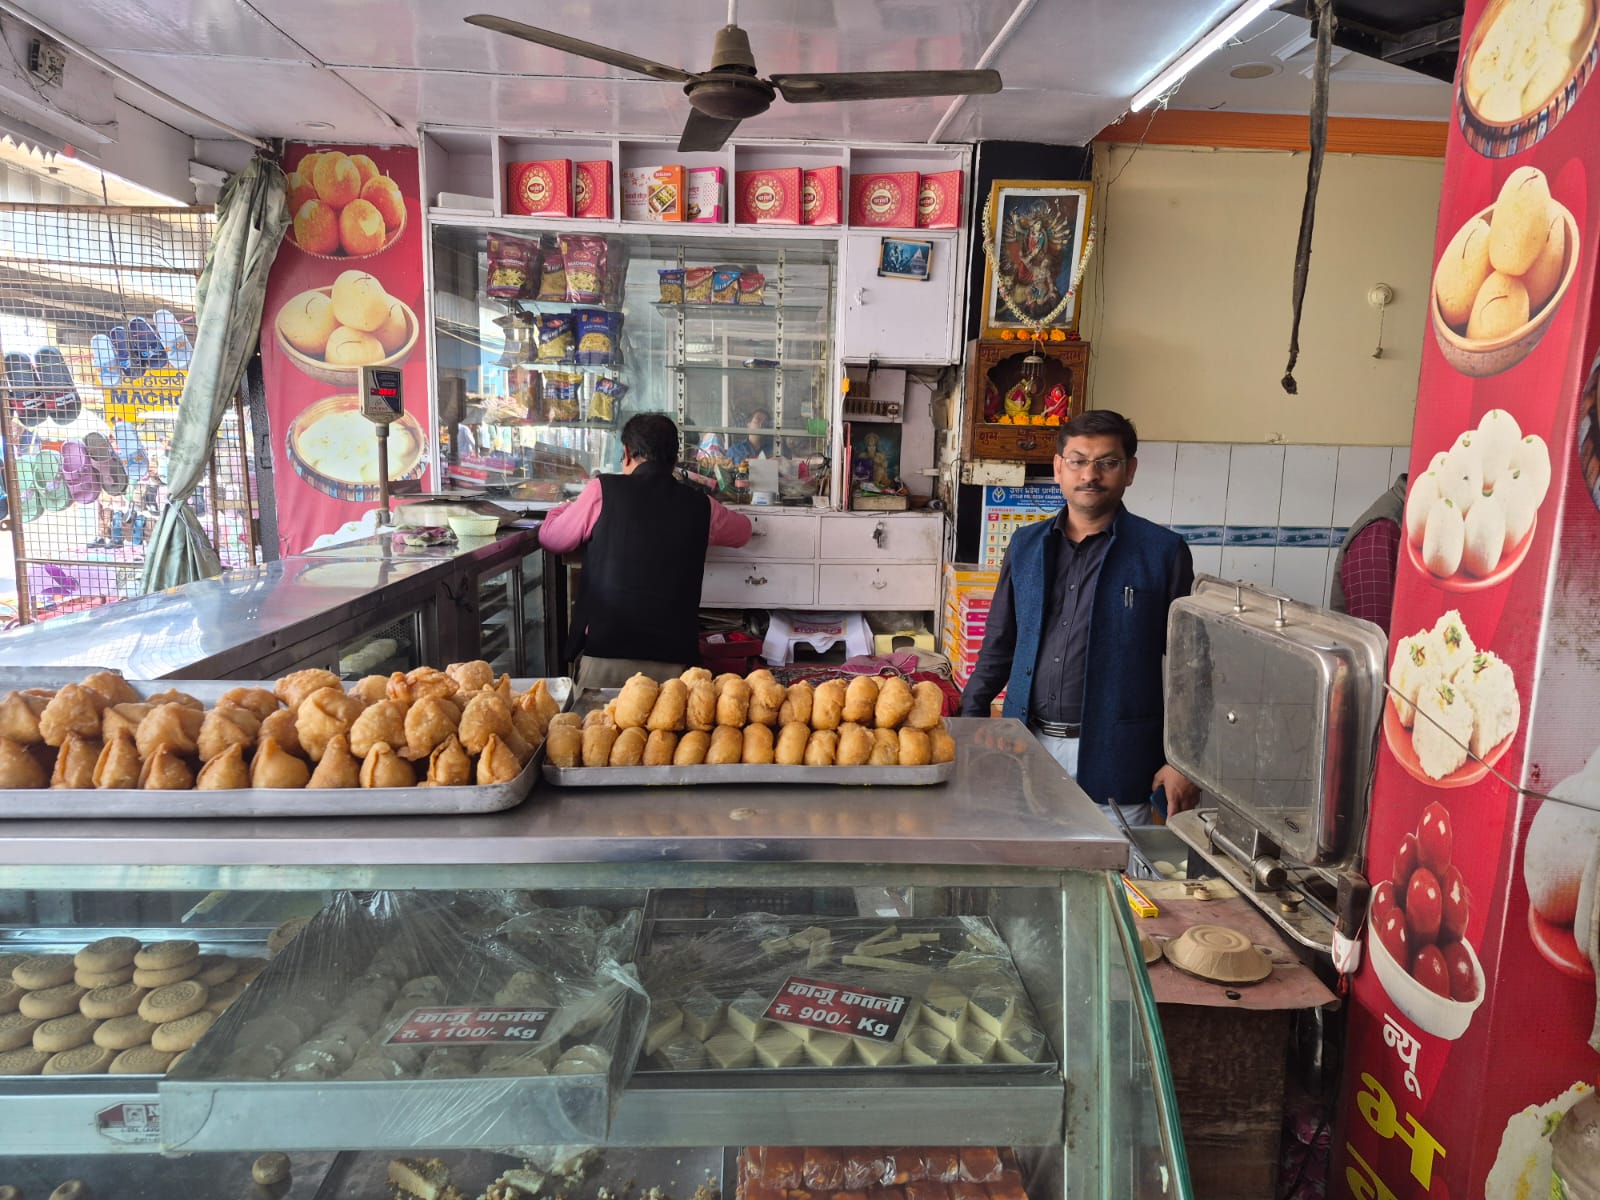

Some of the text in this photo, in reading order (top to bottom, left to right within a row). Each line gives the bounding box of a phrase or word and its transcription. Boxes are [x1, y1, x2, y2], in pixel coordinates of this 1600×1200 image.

[787, 982, 905, 1014] काजू कतली
[414, 1011, 548, 1026] काजू गजक
[429, 1027, 497, 1038] 1100/-
[504, 1026, 537, 1039] Kg
[775, 1003, 889, 1037] रु. 900/- Kg
[1383, 1012, 1422, 1100] न्यू
